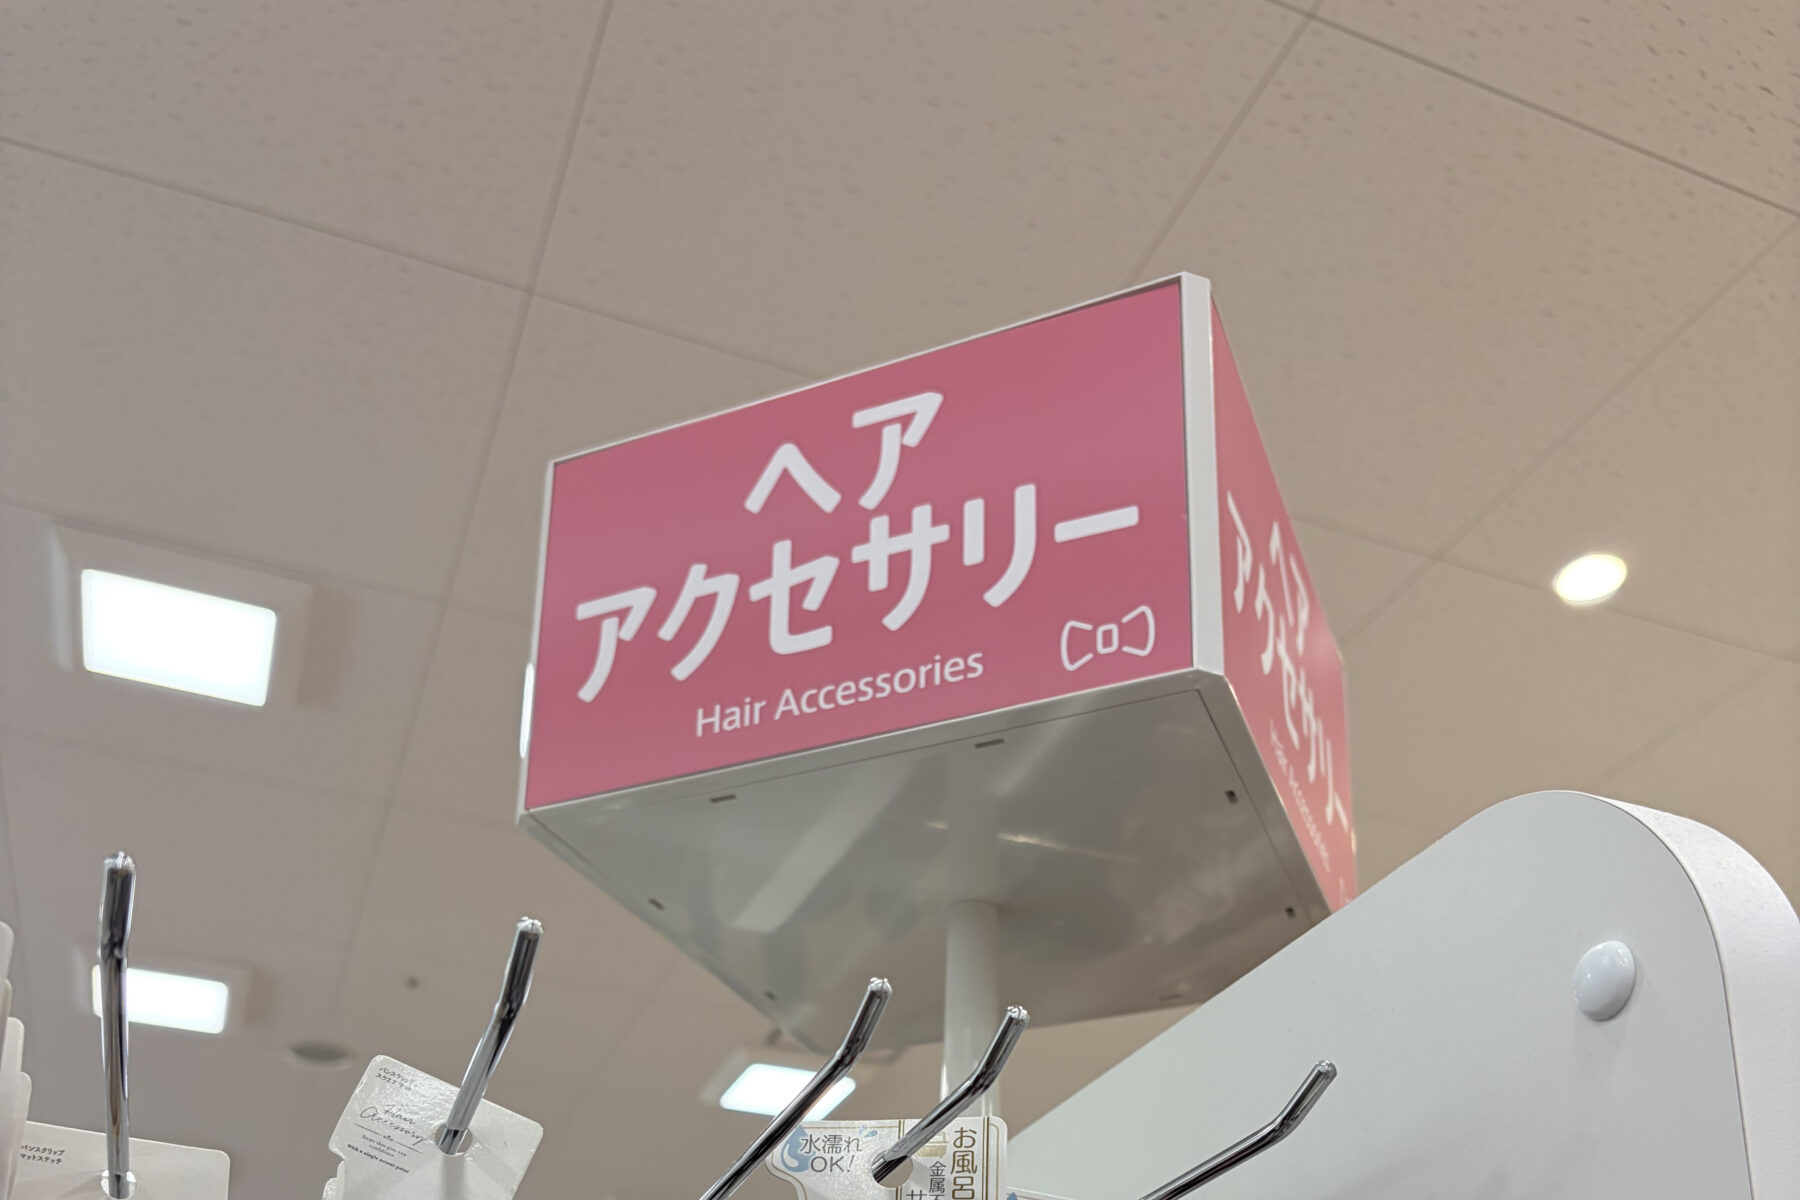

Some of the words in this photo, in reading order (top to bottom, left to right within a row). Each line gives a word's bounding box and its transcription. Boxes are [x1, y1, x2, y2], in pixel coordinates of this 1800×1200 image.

[744, 391, 944, 514] ヘア
[576, 483, 1139, 703] アクセサリー
[696, 697, 766, 738] Hair
[774, 652, 984, 722] Accessories
[800, 1134, 863, 1155] 水濡れ
[810, 1155, 854, 1173] OK!
